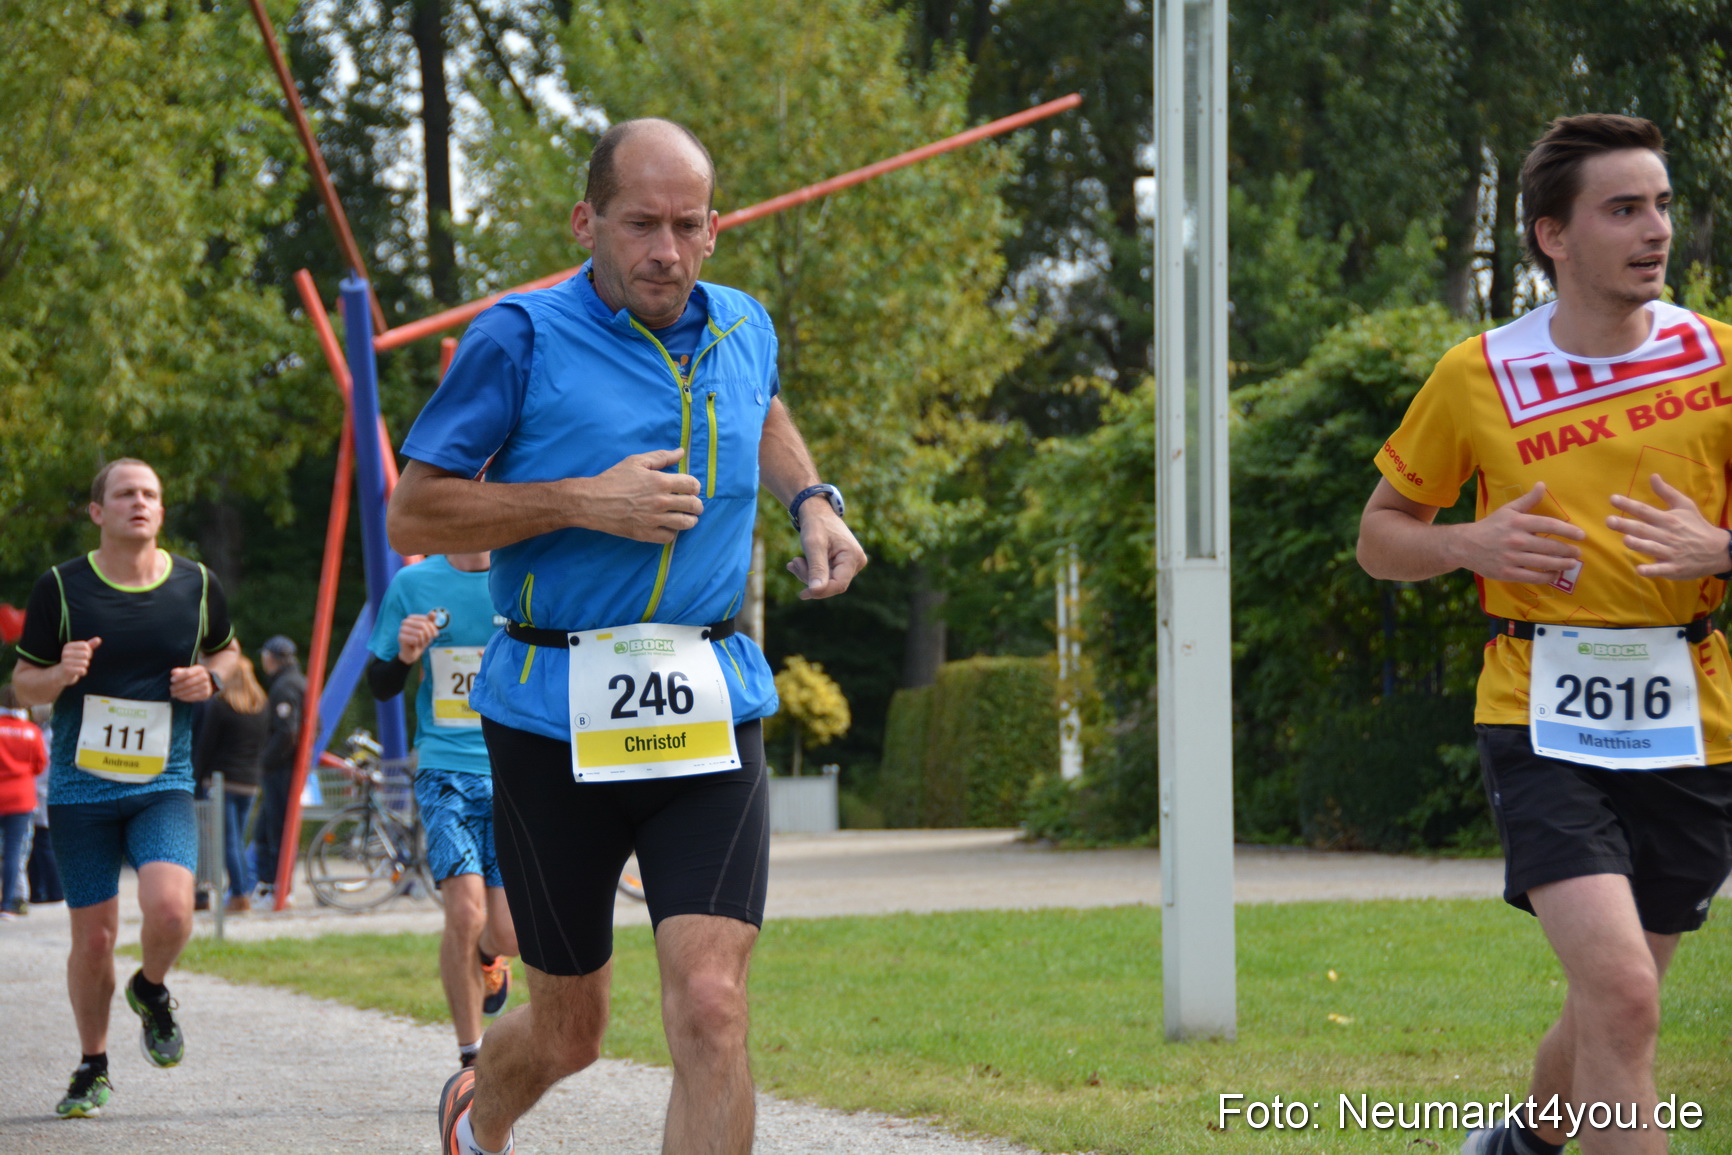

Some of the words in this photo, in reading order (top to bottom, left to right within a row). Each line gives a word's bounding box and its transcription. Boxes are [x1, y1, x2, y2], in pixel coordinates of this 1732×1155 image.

[1516, 415, 1616, 465] MAX
[1626, 381, 1732, 431] BÖGL
[1384, 440, 1424, 486] boegl.de
[629, 639, 674, 652] BOCK
[1594, 643, 1649, 657] BOCK
[608, 671, 694, 720] 246
[1555, 674, 1672, 721] 2616
[103, 724, 145, 751] 111
[624, 732, 687, 752] Christof
[1578, 732, 1652, 750] Matthias
[103, 756, 139, 768] Andreas
